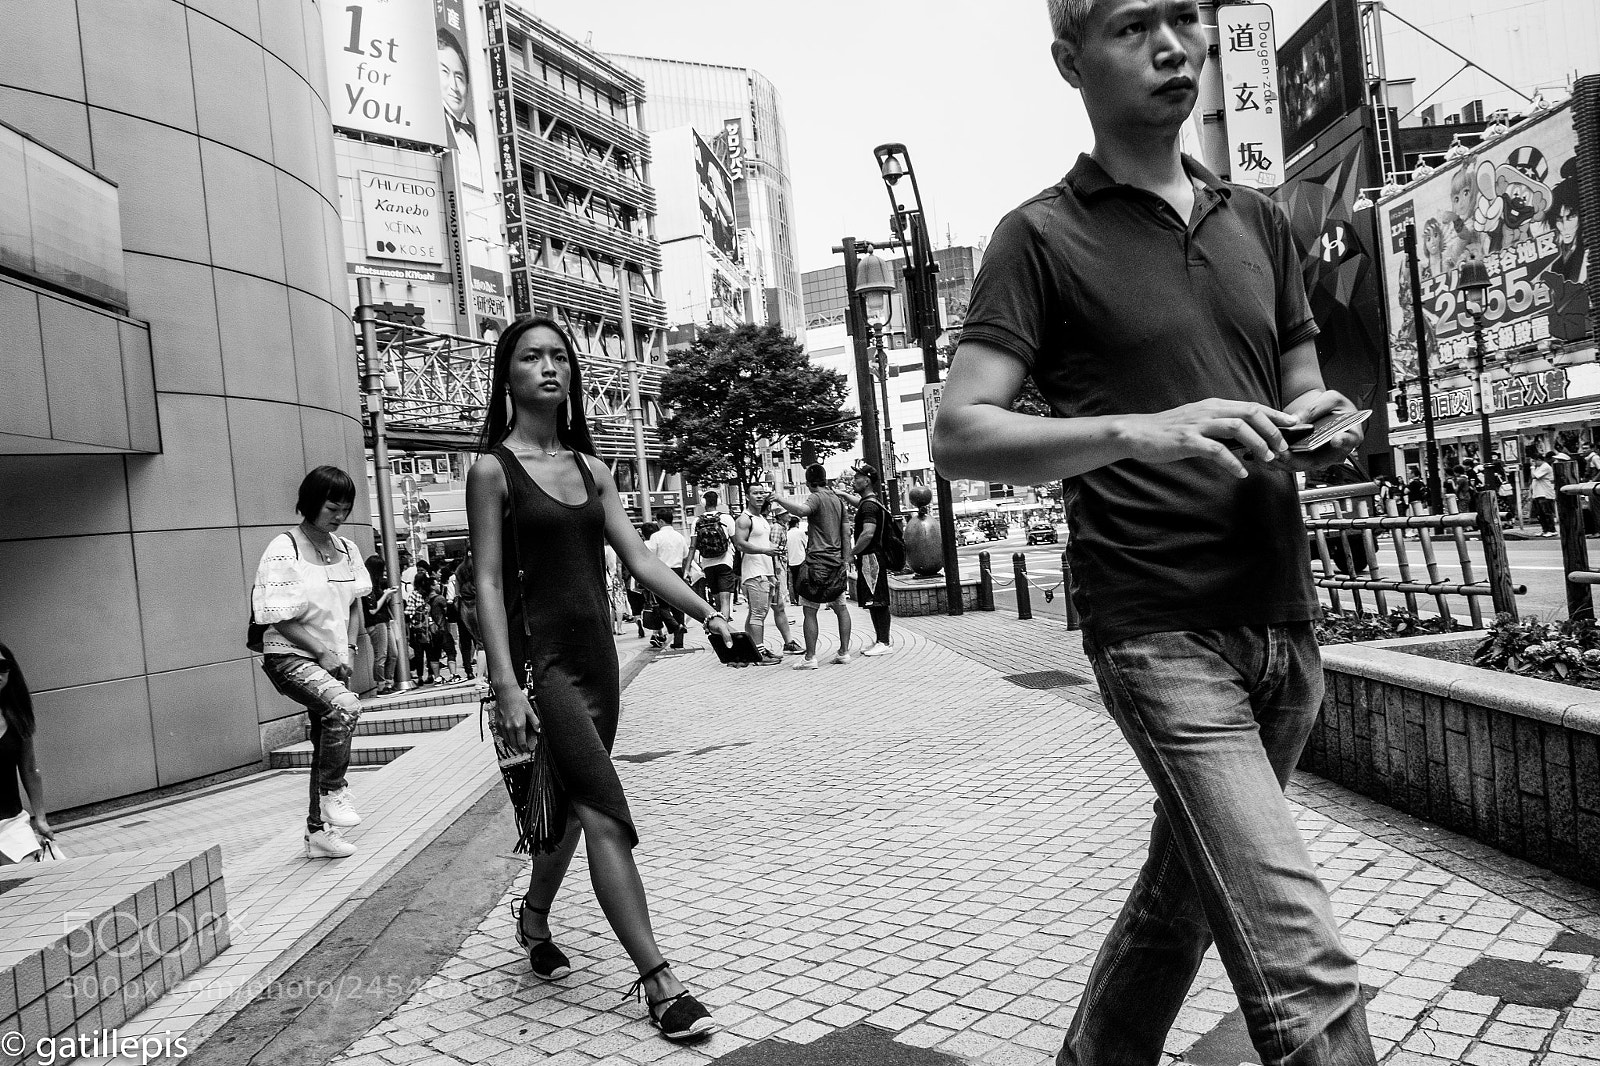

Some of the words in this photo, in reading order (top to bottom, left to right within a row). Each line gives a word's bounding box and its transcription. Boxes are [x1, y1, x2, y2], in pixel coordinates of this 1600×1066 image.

[343, 5, 399, 63] 1st
[356, 62, 391, 86] for
[1257, 21, 1278, 115] Dougen-zaka
[1228, 23, 1262, 171] 道玄坂
[726, 123, 744, 181] サロンパス
[363, 176, 436, 198] SHISEIDO
[374, 198, 429, 217] Kanebo
[384, 220, 422, 235] SOFINA
[354, 265, 404, 279] Matsumoto
[453, 240, 467, 316] Matsumoto
